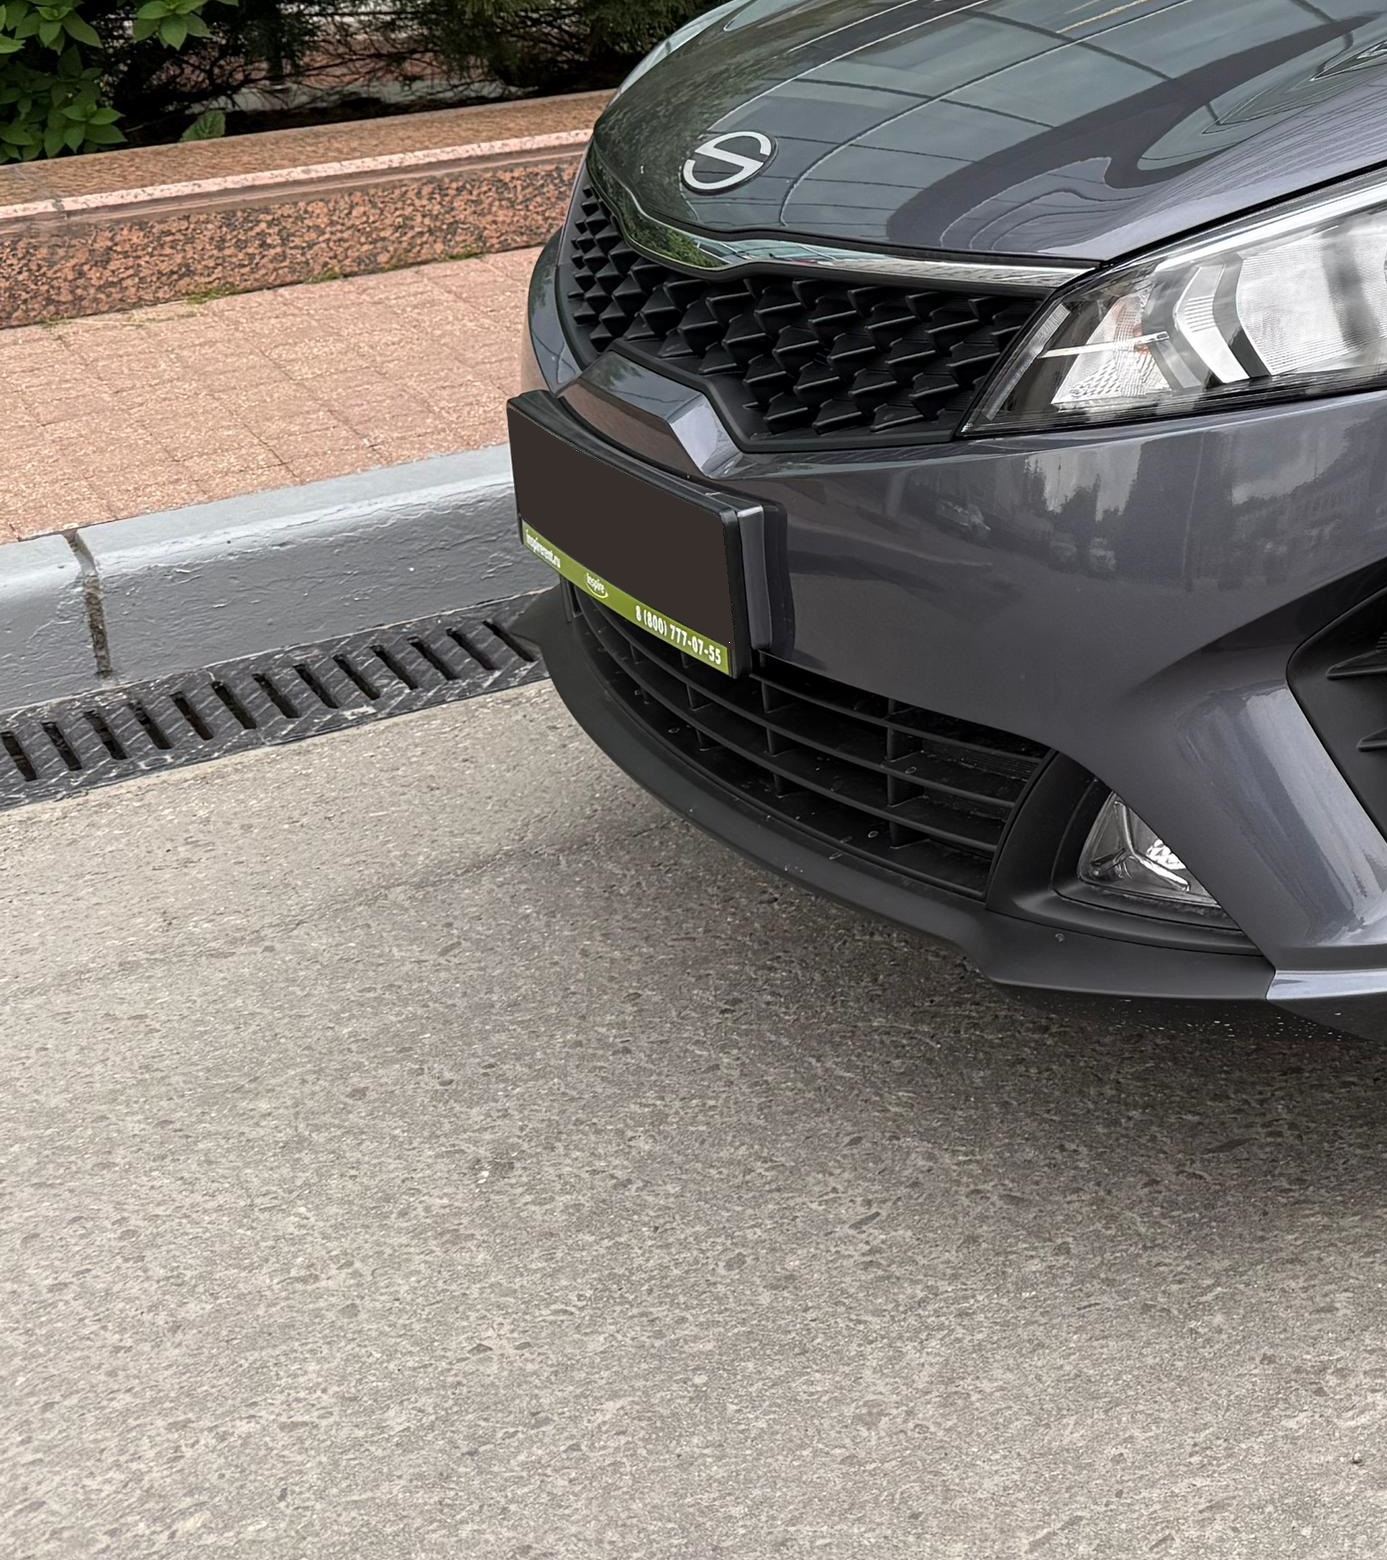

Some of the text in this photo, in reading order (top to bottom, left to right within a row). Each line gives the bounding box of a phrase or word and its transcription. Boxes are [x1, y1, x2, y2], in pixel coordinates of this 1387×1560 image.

[635, 605, 722, 665] 8 (800) 777-07-55
